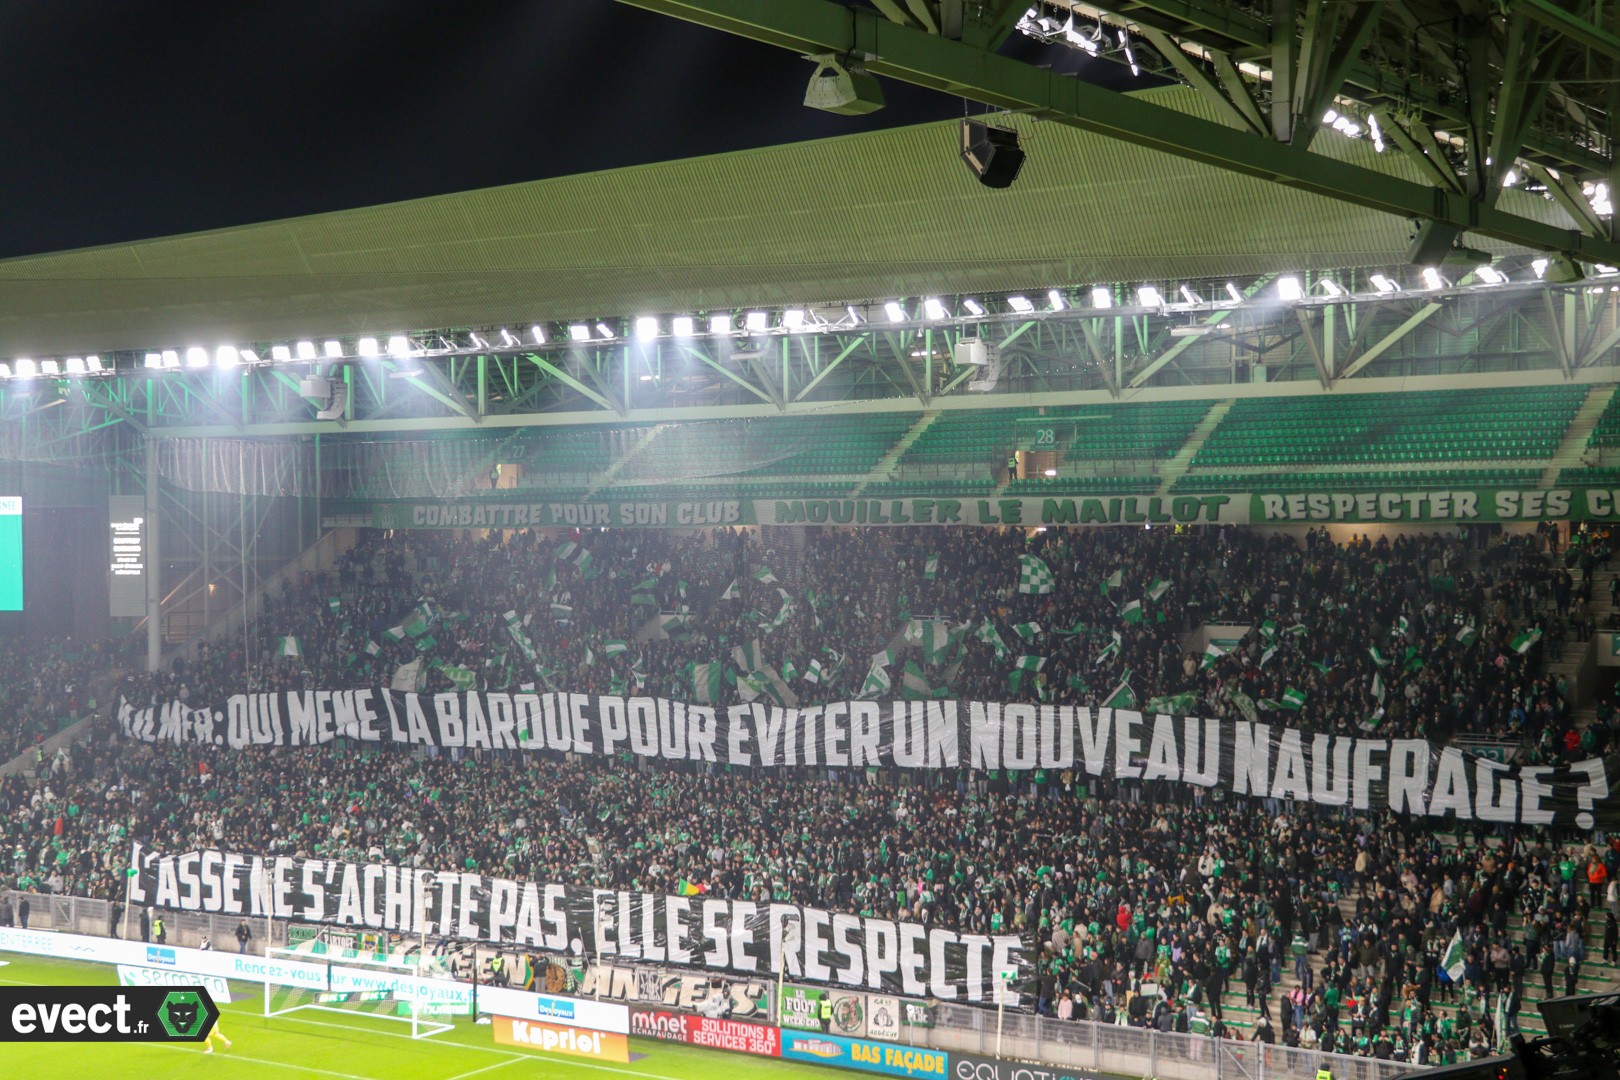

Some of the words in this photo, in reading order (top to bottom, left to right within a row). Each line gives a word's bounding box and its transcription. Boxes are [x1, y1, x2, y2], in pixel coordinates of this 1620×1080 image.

[1037, 428, 1054, 444] 28
[413, 504, 542, 526] COMBATTRE
[552, 504, 610, 525] POUR
[620, 504, 667, 525] SON
[676, 501, 741, 524] CLUB
[775, 497, 961, 525] MOUILLER
[978, 498, 1023, 524] LE
[1041, 493, 1230, 524] MAILLOT
[1260, 492, 1478, 520] RESPECTER
[1495, 490, 1572, 518] SES
[227, 692, 283, 750] QUI
[287, 689, 381, 746] MENE
[381, 687, 433, 746] LA
[433, 690, 595, 754] BARQUE
[600, 694, 717, 763] POUR
[727, 701, 880, 768] EVITER
[892, 701, 959, 769] UN
[971, 702, 1220, 788] NOUVEAU
[1233, 721, 1556, 825] NAUFRAGE
[1569, 757, 1609, 830] ?
[130, 842, 244, 913] L'ASSE
[250, 856, 294, 918] NE
[303, 859, 481, 938] S'ACHETE
[592, 889, 692, 964] ELLE
[702, 899, 758, 970] SE
[769, 903, 1022, 1006] RESPECTE
[785, 997, 816, 1013] FOOT
[632, 1011, 687, 1034] minet
[632, 1026, 687, 1041] ECHAFAUDAGE
[701, 1018, 764, 1039] SOLUTIONS
[767, 1028, 776, 1041] &
[693, 1030, 746, 1050] SERVICES
[749, 1038, 776, 1054] 360°
[851, 1043, 881, 1065] BAS
[885, 1048, 945, 1074] FAÇADE
